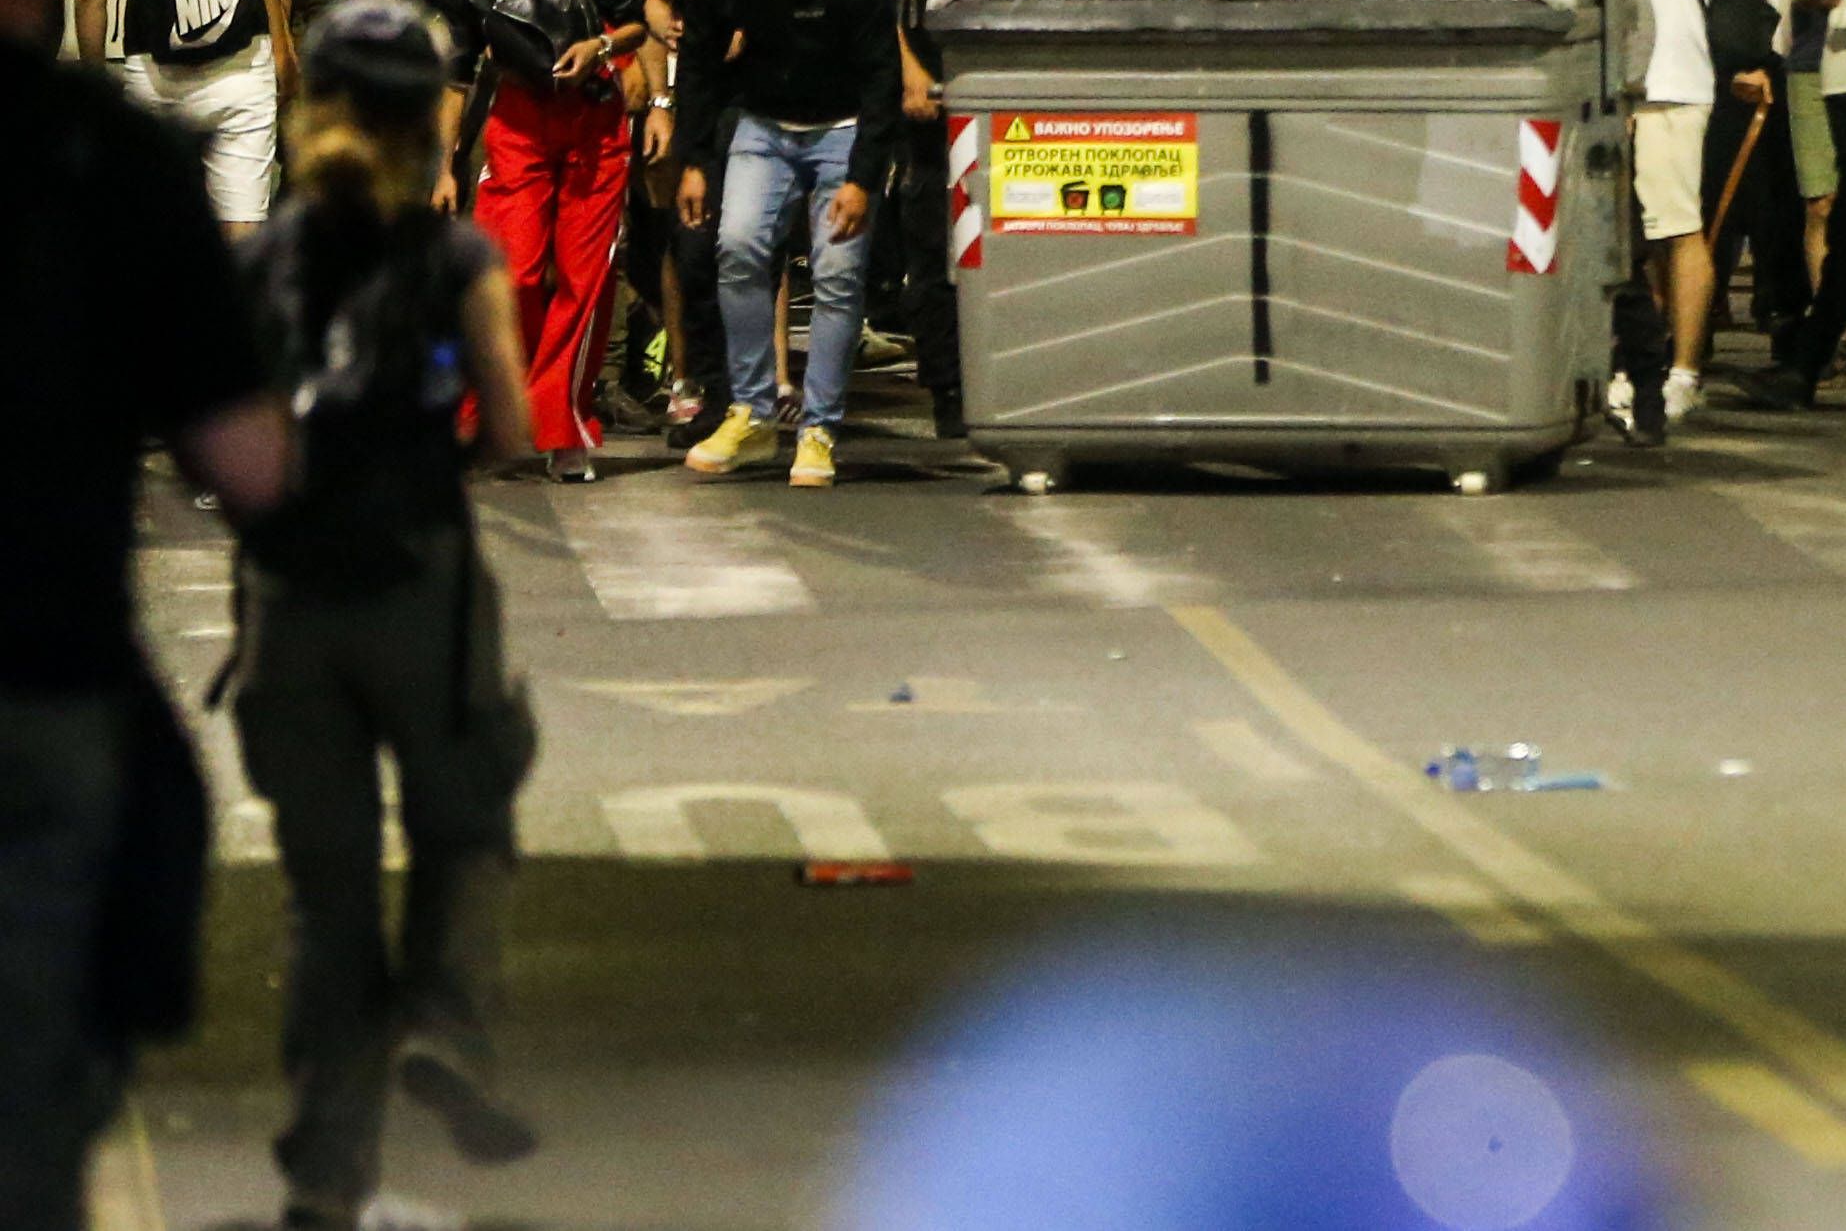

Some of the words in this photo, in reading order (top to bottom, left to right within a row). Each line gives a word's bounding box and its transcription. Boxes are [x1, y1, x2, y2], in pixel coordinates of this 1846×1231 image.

[1034, 121, 1091, 136] ВАЖНО
[1093, 121, 1185, 137] УПОЗОРЕЊЕ
[1004, 149, 1081, 161] ОТВОРЕН
[1085, 149, 1182, 164] ПОКЛОПАЦ
[1004, 164, 1094, 178] УГРОЖАВА
